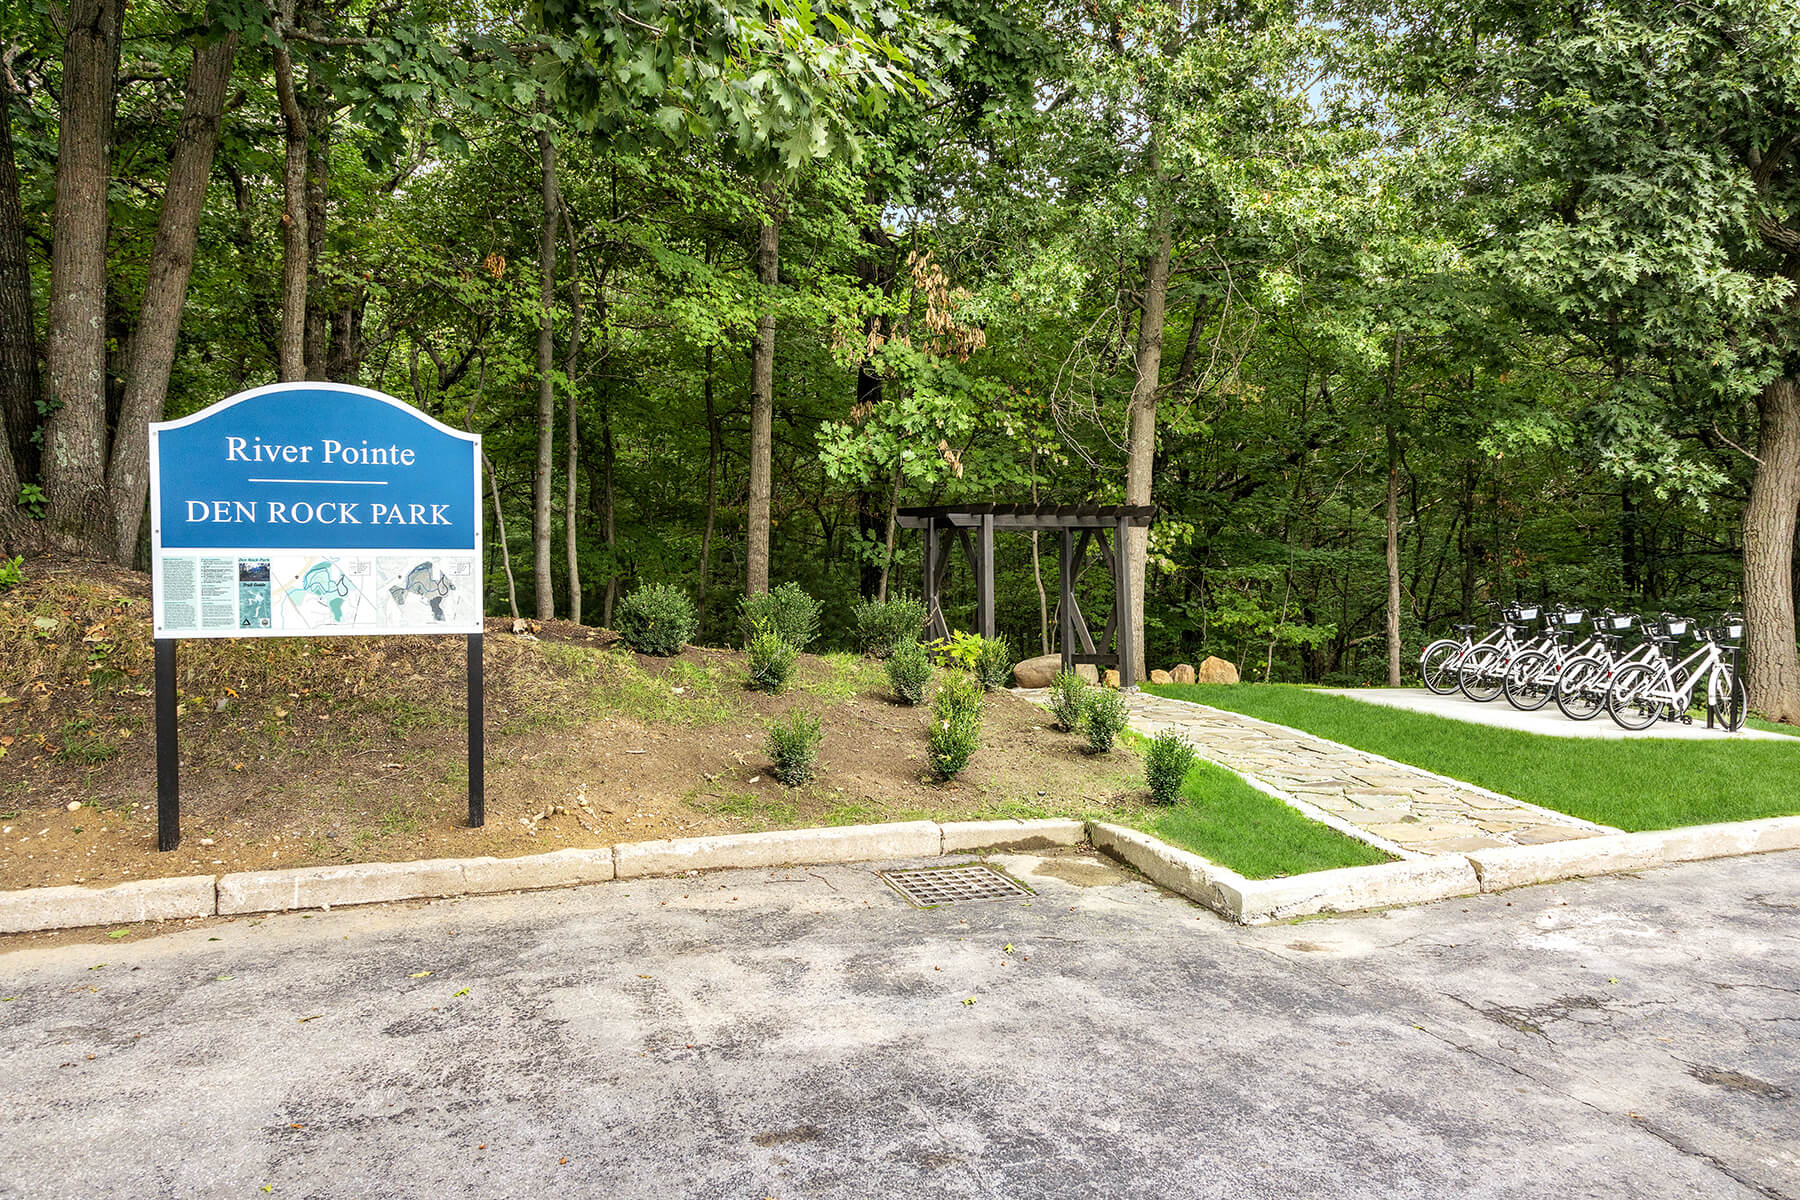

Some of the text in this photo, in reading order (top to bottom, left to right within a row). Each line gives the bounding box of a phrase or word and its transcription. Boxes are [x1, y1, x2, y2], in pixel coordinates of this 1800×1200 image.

[225, 436, 416, 466] River Pointe
[185, 500, 453, 526] DEN ROCK PARK
